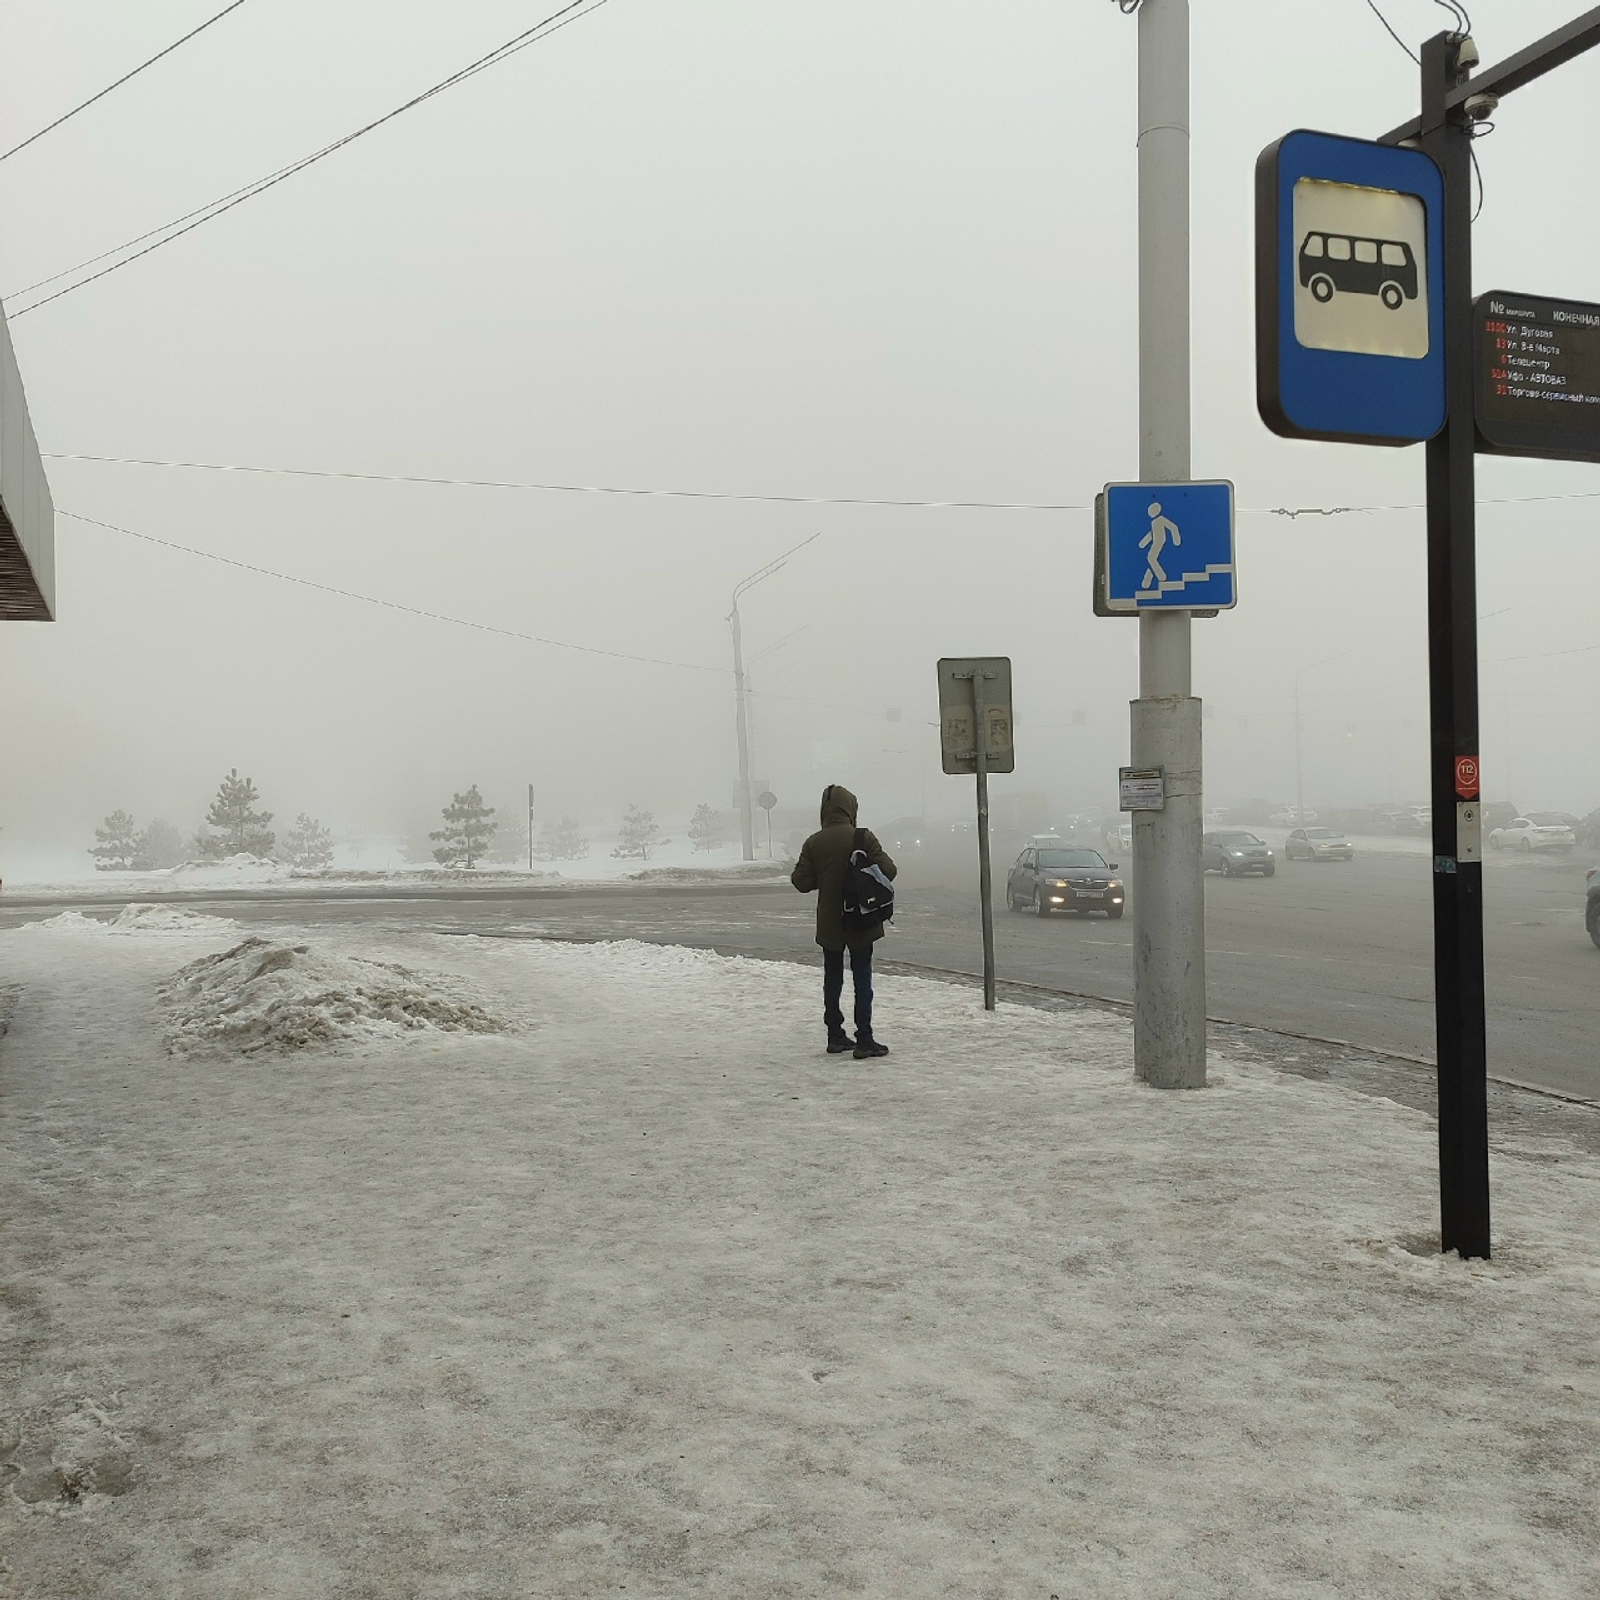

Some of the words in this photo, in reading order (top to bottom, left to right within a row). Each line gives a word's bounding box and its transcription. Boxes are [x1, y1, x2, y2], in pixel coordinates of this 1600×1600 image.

[1490, 300, 1504, 314] №
[1553, 310, 1600, 326] КОНЕЧНАЯ
[1535, 343, 1560, 356] Марта
[1507, 354, 1550, 370] Телецентр
[1529, 372, 1567, 385] АВТОВАЗ
[1461, 764, 1474, 774] 112
